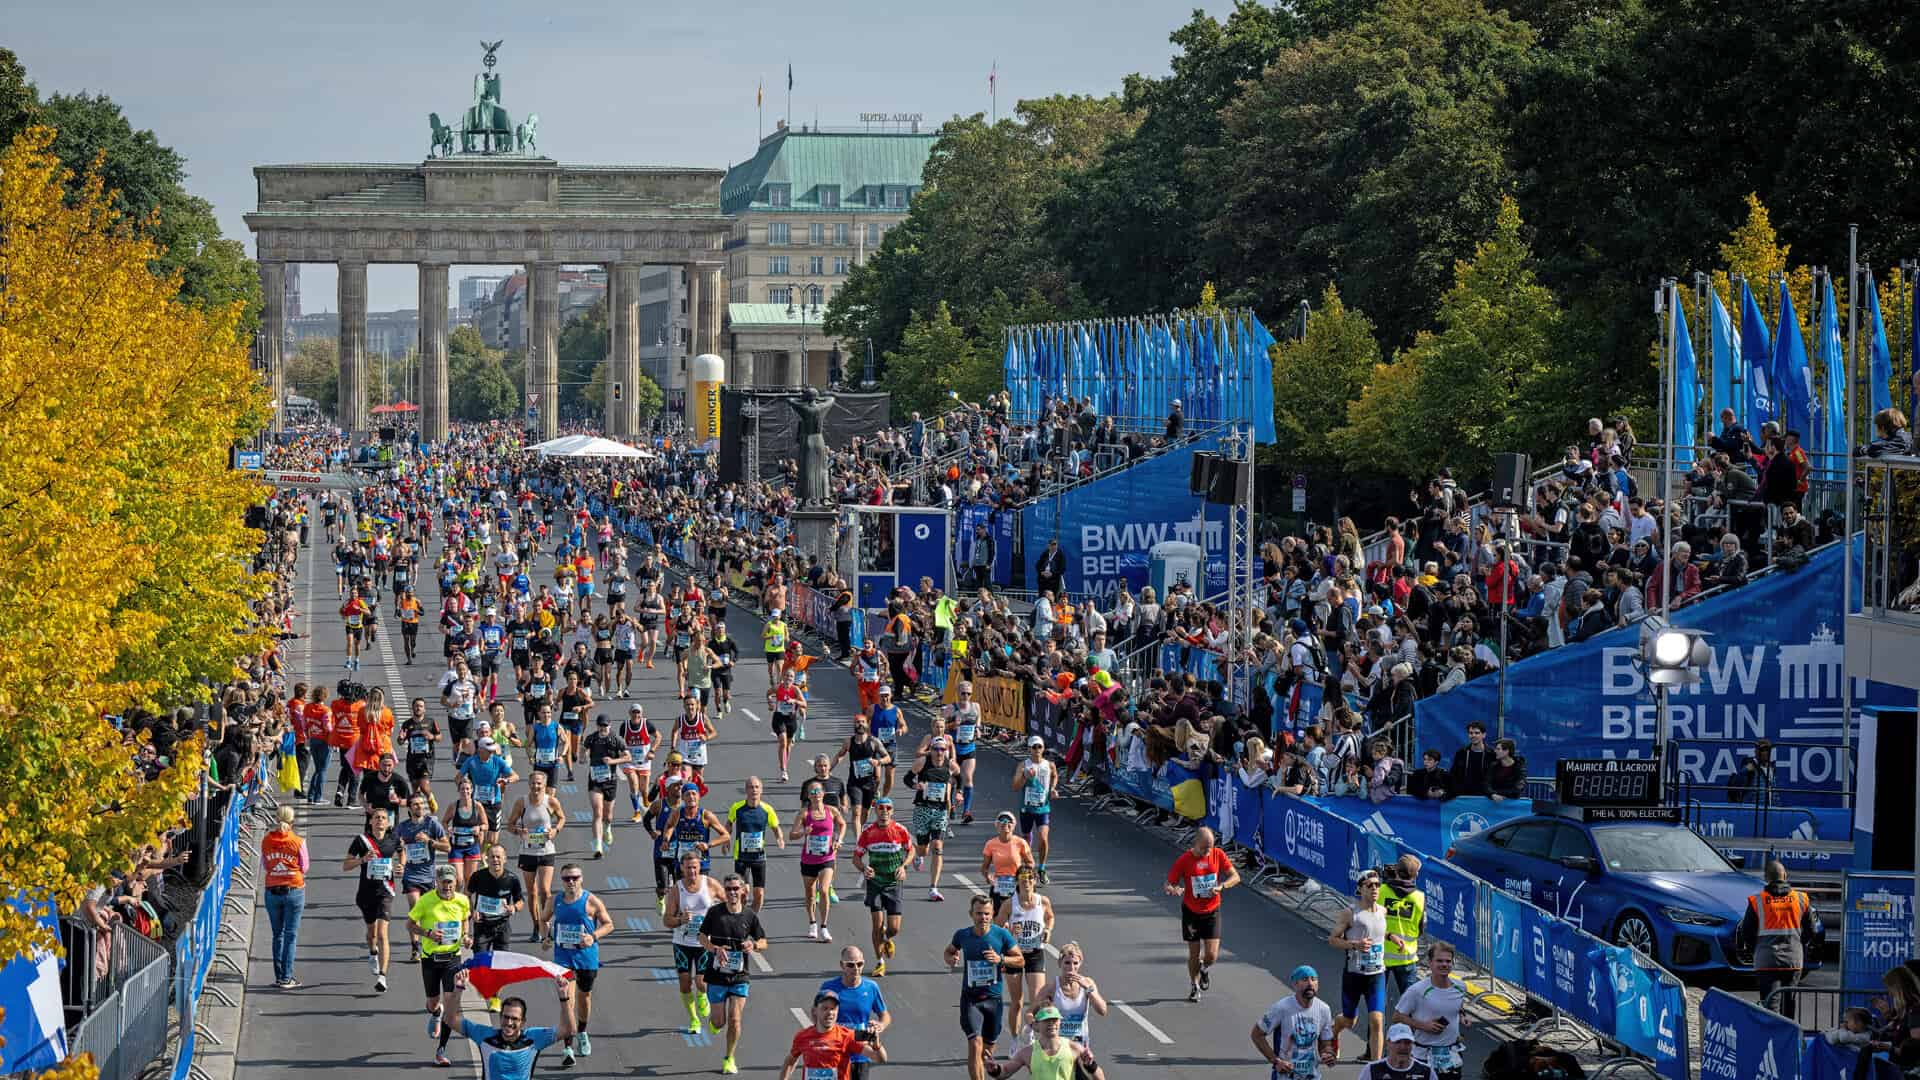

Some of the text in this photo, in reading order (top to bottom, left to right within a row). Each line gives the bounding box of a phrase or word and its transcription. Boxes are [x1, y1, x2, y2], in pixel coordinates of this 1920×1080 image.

[859, 113, 922, 122] HOTEL ADLON
[279, 475, 321, 484] mateco
[1081, 523, 1168, 552] BMW
[1602, 704, 1765, 740] BERLIN
[1566, 761, 1603, 772] MAURICE
[1620, 762, 1657, 772] LACROIX
[1592, 809, 1605, 817] THE
[1618, 809, 1638, 818] 100%
[266, 853, 300, 863] BERLIN
[1505, 878, 1521, 891] BMW
